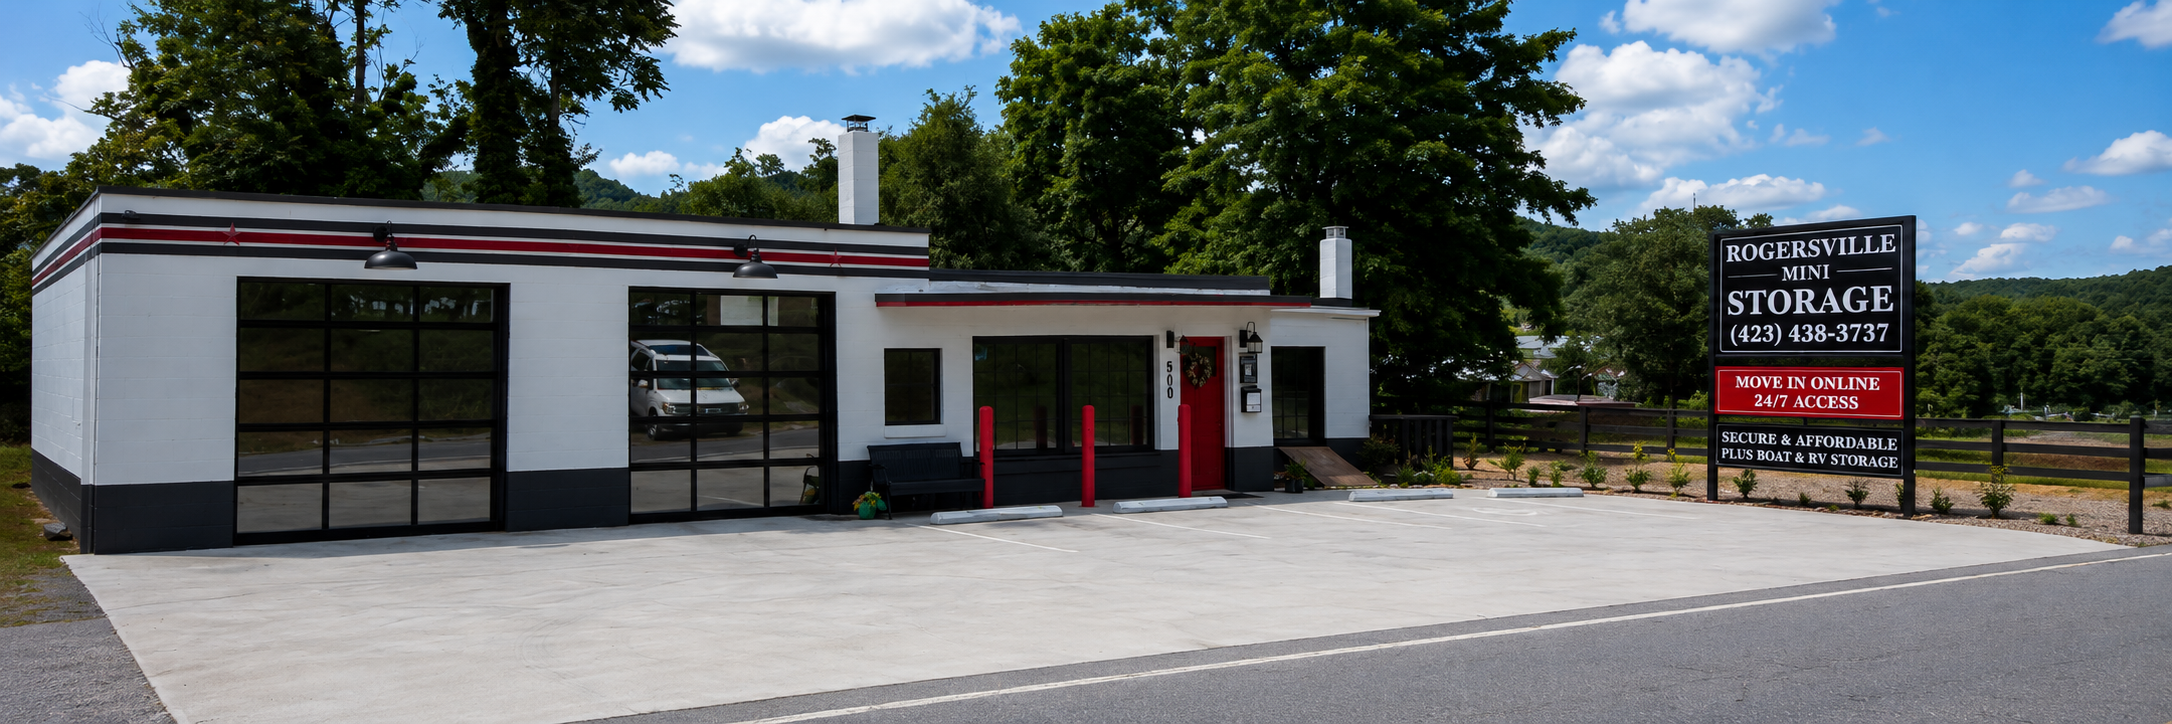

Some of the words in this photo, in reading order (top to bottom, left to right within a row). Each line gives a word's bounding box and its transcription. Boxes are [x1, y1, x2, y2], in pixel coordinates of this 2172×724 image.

[1726, 233, 1896, 263] ROGERSVILLE
[1781, 264, 1830, 282] MINI
[1727, 285, 1894, 316] STORAGE
[1730, 323, 1782, 346] (423)
[1788, 323, 1889, 343] 438-3737
[1166, 360, 1174, 399] 500
[1735, 375, 1783, 389] MOVE
[1787, 376, 1807, 390] IN
[1810, 376, 1880, 391] ONLINE
[1754, 394, 1788, 409] 24/7
[1793, 395, 1859, 410] ACCESS
[1721, 431, 1777, 445] SECURE
[1781, 433, 1792, 446] &
[1795, 434, 1898, 451] AFFORDABLE
[1721, 448, 1753, 461] PLUS
[1757, 450, 1792, 463] BOAT
[1794, 451, 1805, 463] &
[1808, 452, 1827, 465] RV
[1830, 453, 1899, 469] STORAGE
